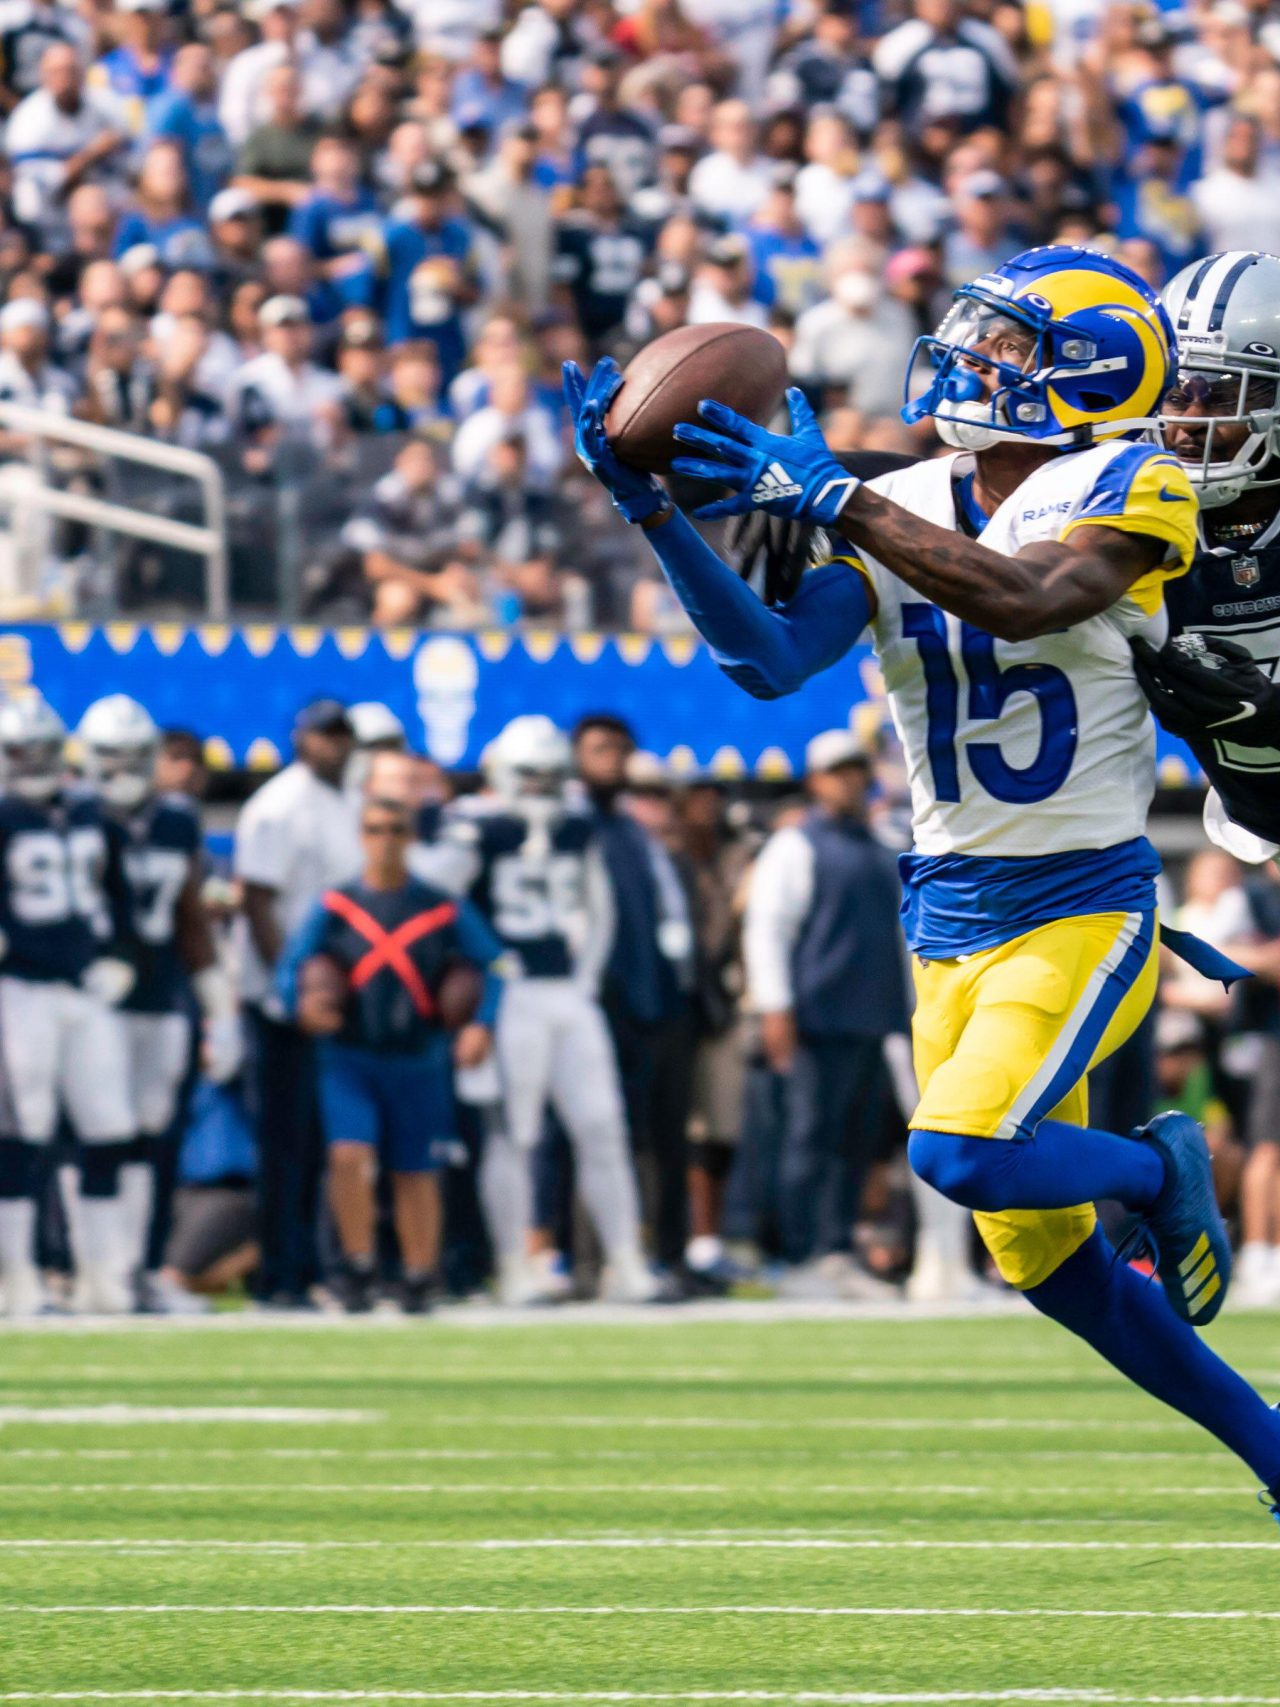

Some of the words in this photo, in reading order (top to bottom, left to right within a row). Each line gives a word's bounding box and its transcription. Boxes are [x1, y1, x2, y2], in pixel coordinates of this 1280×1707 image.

[751, 483, 804, 503] adidas
[1022, 501, 1073, 522] RAMS
[901, 602, 1078, 805] 15
